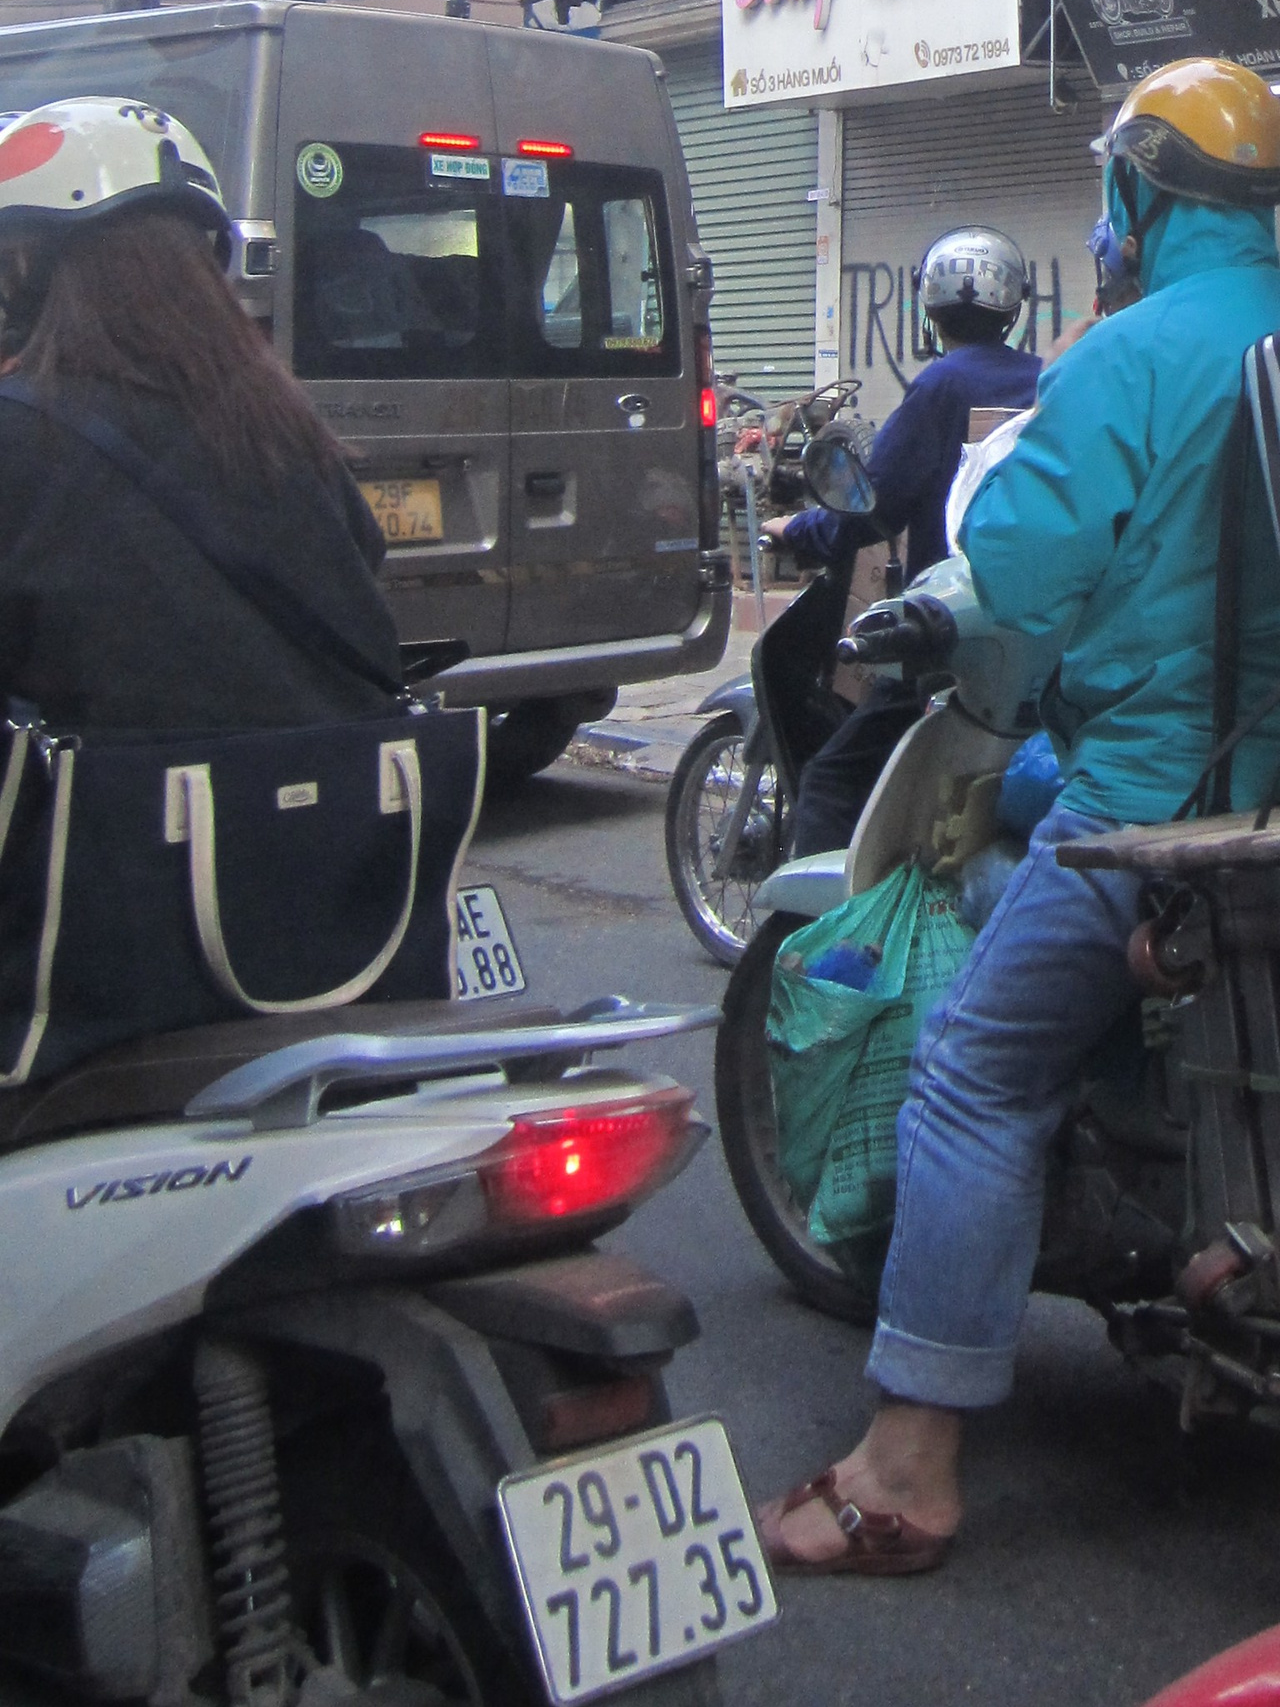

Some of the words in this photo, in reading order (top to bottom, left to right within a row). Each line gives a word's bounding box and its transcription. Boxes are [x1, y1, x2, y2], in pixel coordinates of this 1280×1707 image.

[750, 67, 767, 93] SỐ
[769, 76, 776, 92] 3
[777, 68, 811, 90] HÀNG
[811, 56, 841, 85] MUỐI
[933, 47, 962, 67] 0973
[963, 44, 980, 63] 72
[982, 38, 1010, 59] 1994
[433, 159, 444, 172] XE
[66, 1155, 253, 1210] VISION
[542, 1440, 719, 1575] 29-D2
[546, 1528, 764, 1688] 727.35
